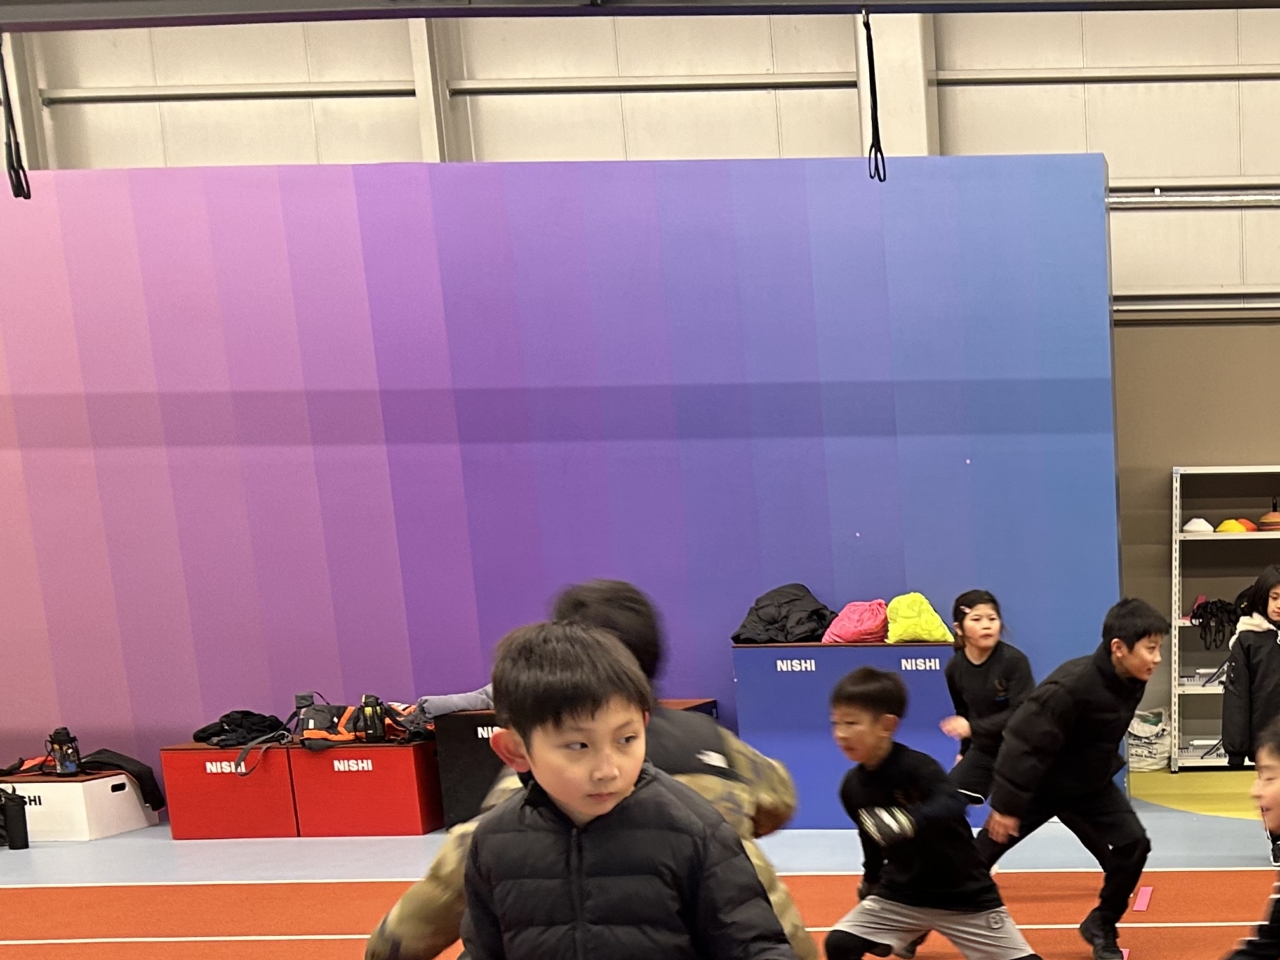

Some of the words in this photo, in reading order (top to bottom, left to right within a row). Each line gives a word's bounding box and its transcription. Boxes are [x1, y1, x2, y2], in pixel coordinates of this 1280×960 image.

[776, 659, 816, 671] NISHI
[901, 658, 940, 670] NISHI
[333, 759, 373, 772] NISHI
